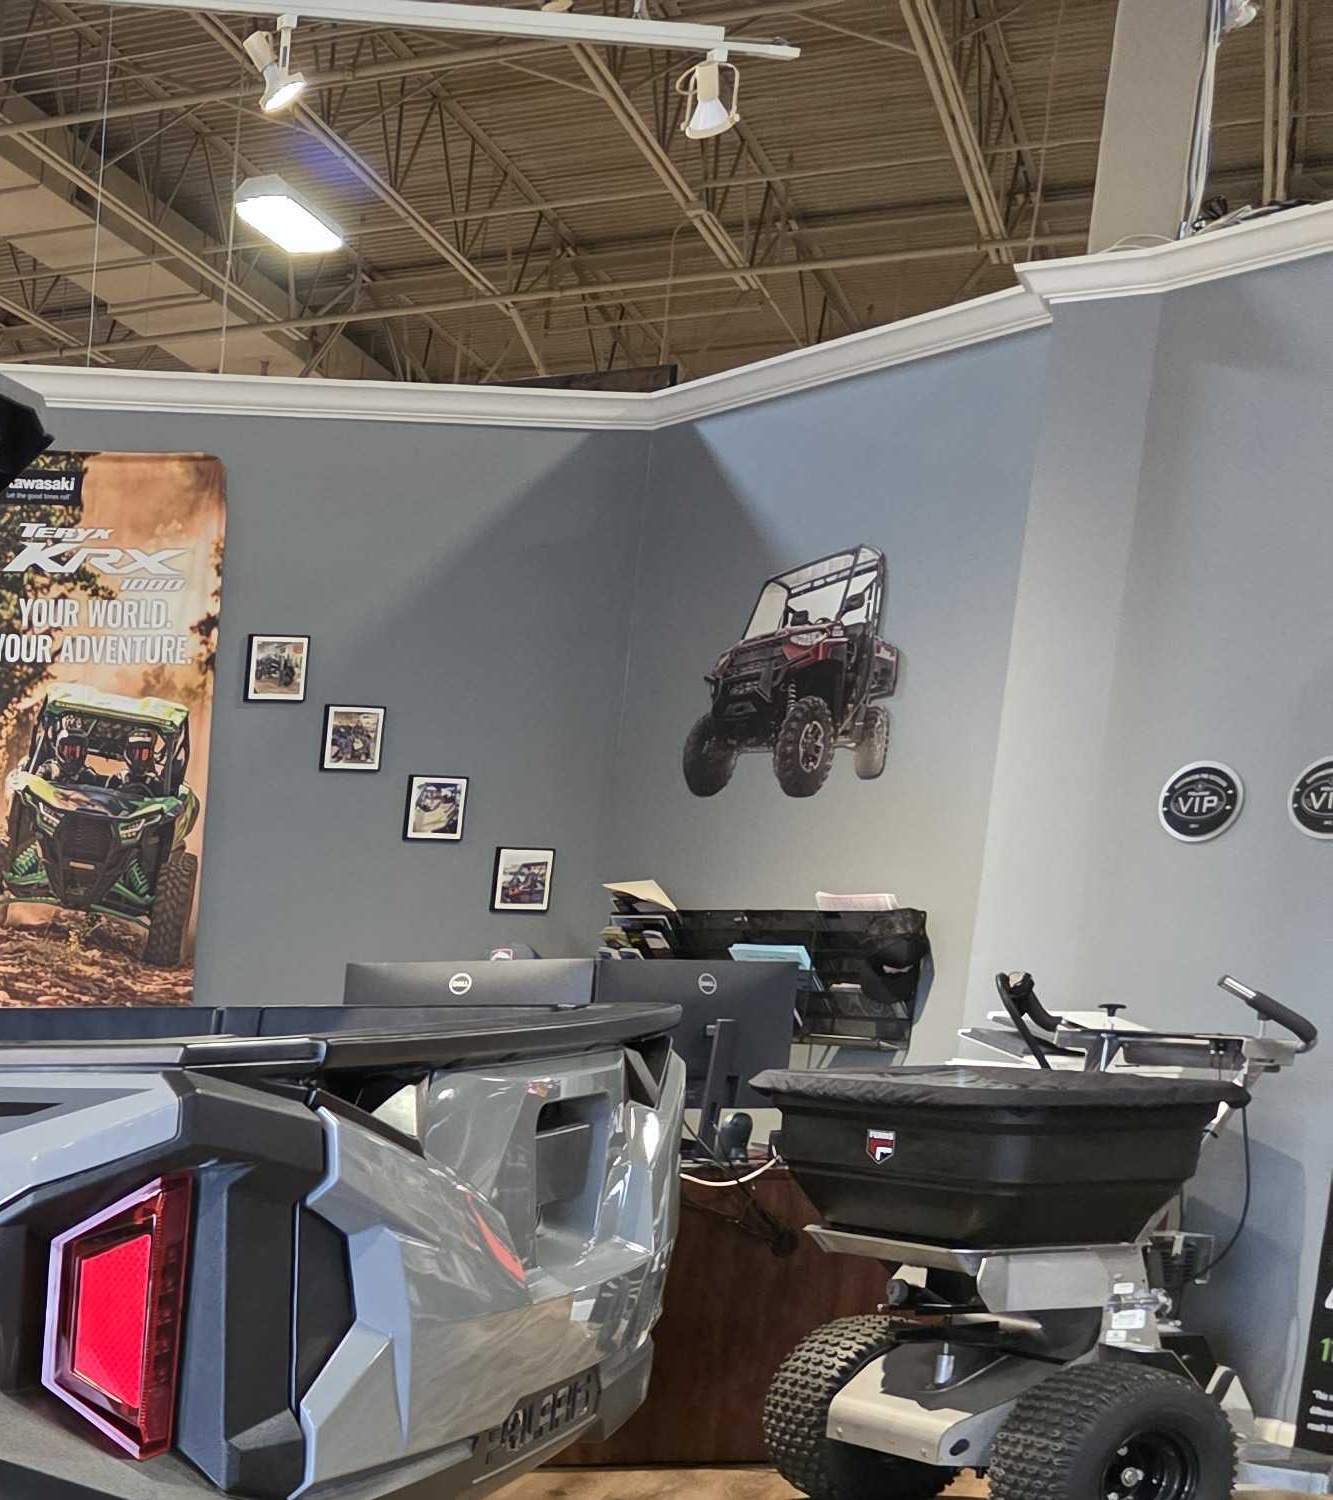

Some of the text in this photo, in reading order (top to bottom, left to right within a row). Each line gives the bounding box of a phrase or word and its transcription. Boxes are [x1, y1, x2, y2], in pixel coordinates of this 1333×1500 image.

[2, 541, 188, 576] KRX
[119, 577, 185, 592] 1000
[19, 598, 173, 629] YOUR WORLD.
[59, 634, 193, 665] ADVENTURE.
[1177, 795, 1219, 814] VIP
